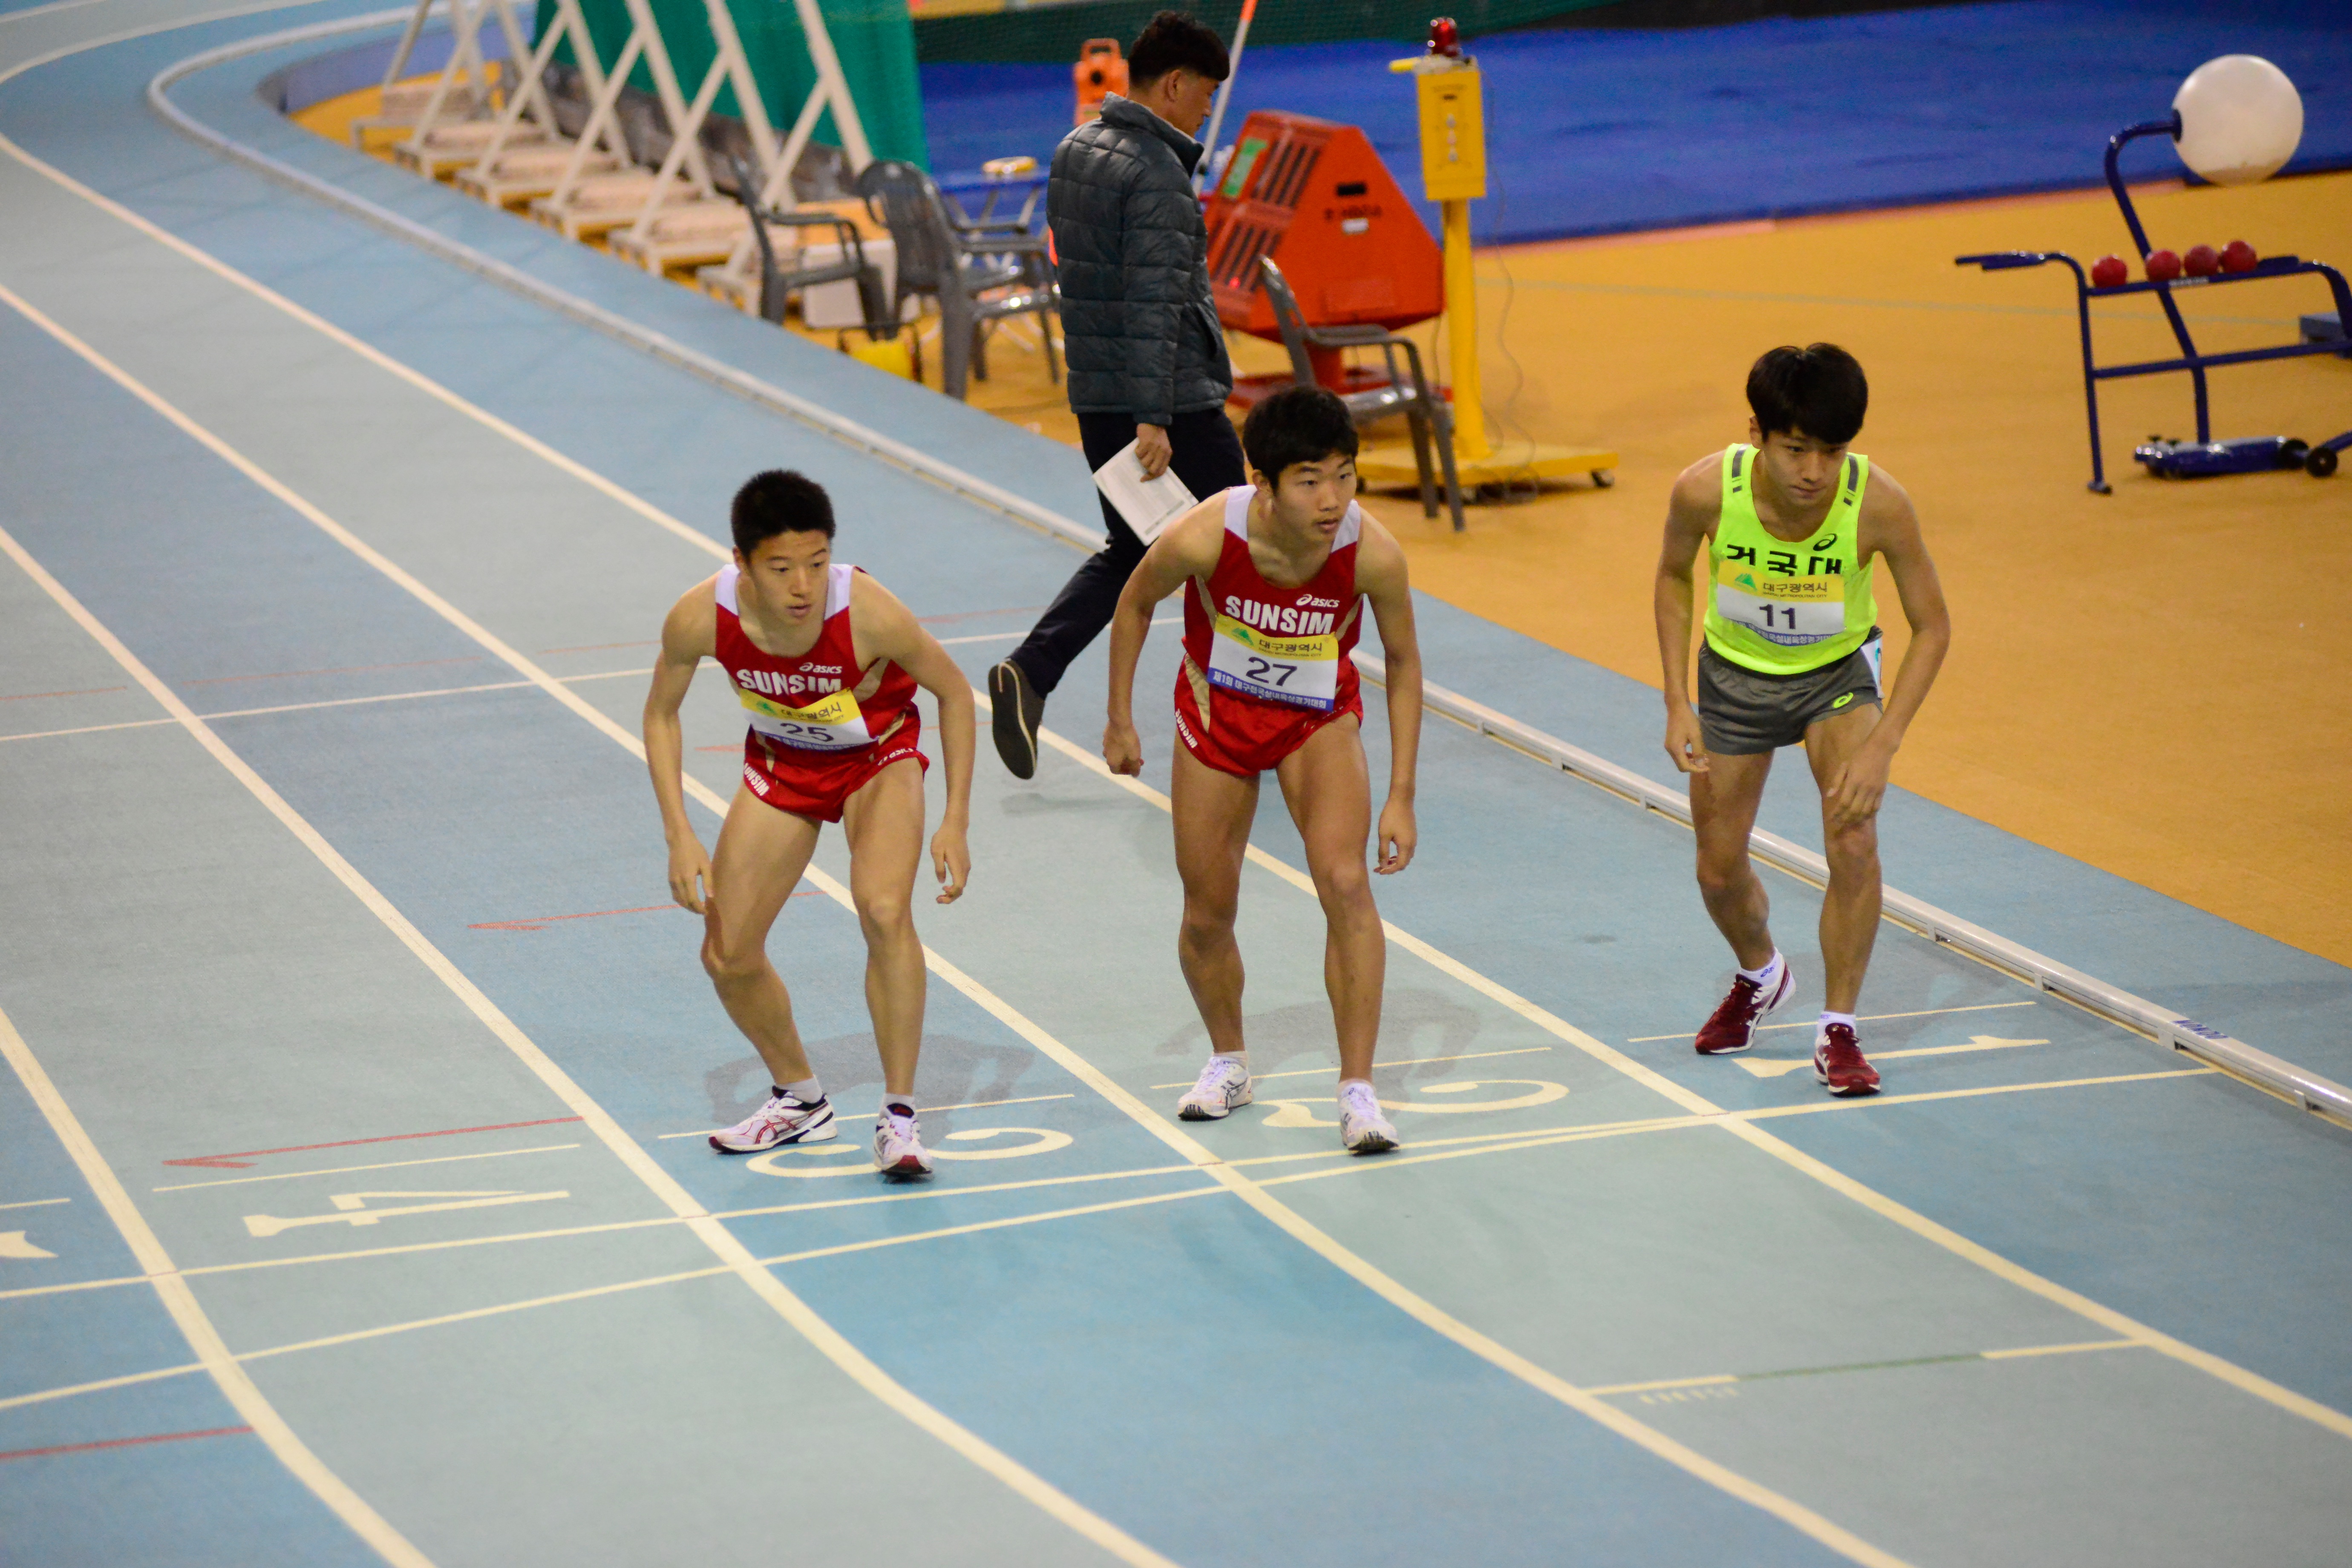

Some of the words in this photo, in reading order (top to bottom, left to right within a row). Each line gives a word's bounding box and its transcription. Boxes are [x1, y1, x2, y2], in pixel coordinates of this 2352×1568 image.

[1762, 582, 1827, 593] 대구광역시
[1311, 597, 1339, 608] asics
[1225, 595, 1335, 635] SUNSIM
[1759, 603, 1796, 630] 11
[1259, 639, 1323, 652] 대구광역시
[813, 664, 842, 674] asics
[1213, 671, 1234, 686] 제1회
[1245, 657, 1297, 686] 27
[736, 669, 842, 695] SUNSIM
[780, 723, 834, 742] 25
[242, 1189, 570, 1238] 4
